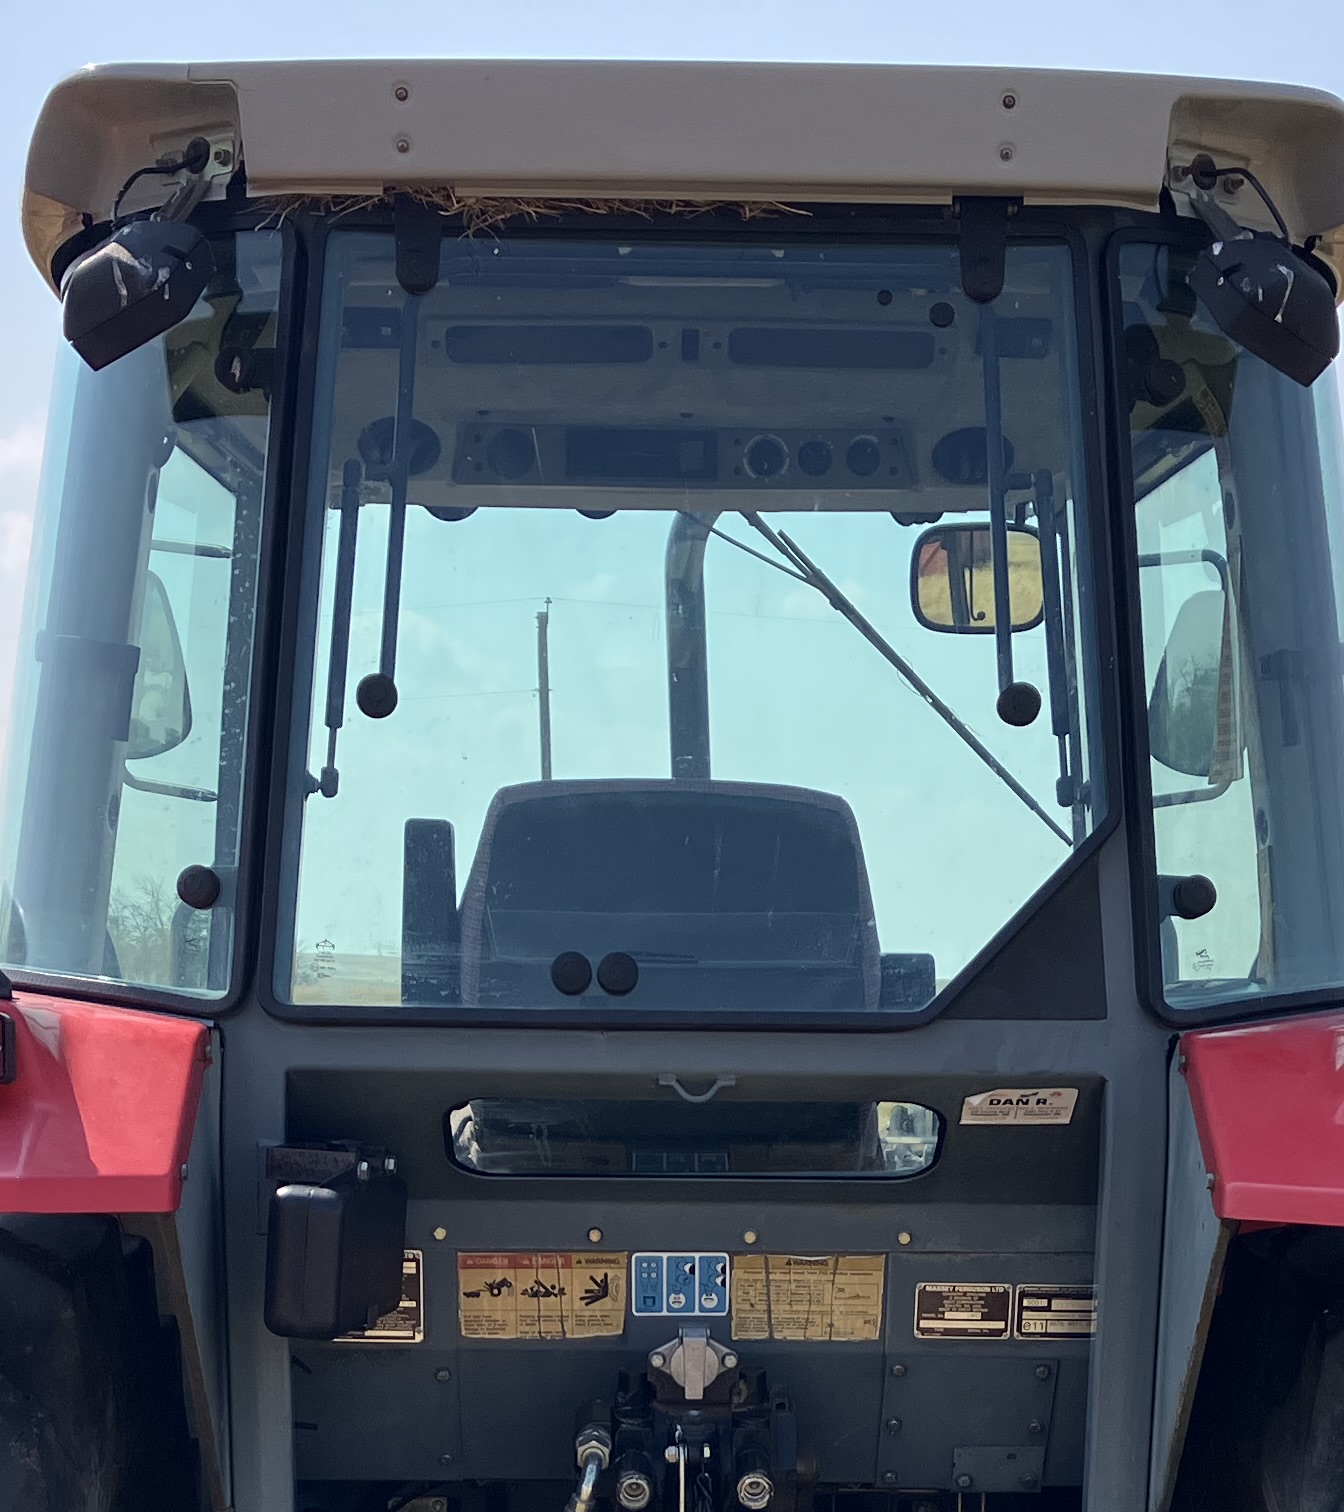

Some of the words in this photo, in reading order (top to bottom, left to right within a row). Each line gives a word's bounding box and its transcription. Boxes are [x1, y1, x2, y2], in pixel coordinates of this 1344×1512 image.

[988, 1098, 1029, 1106] DAN
[475, 1256, 509, 1265] DANGER
[531, 1256, 566, 1265] DNGR
[584, 1256, 621, 1265] WARNING
